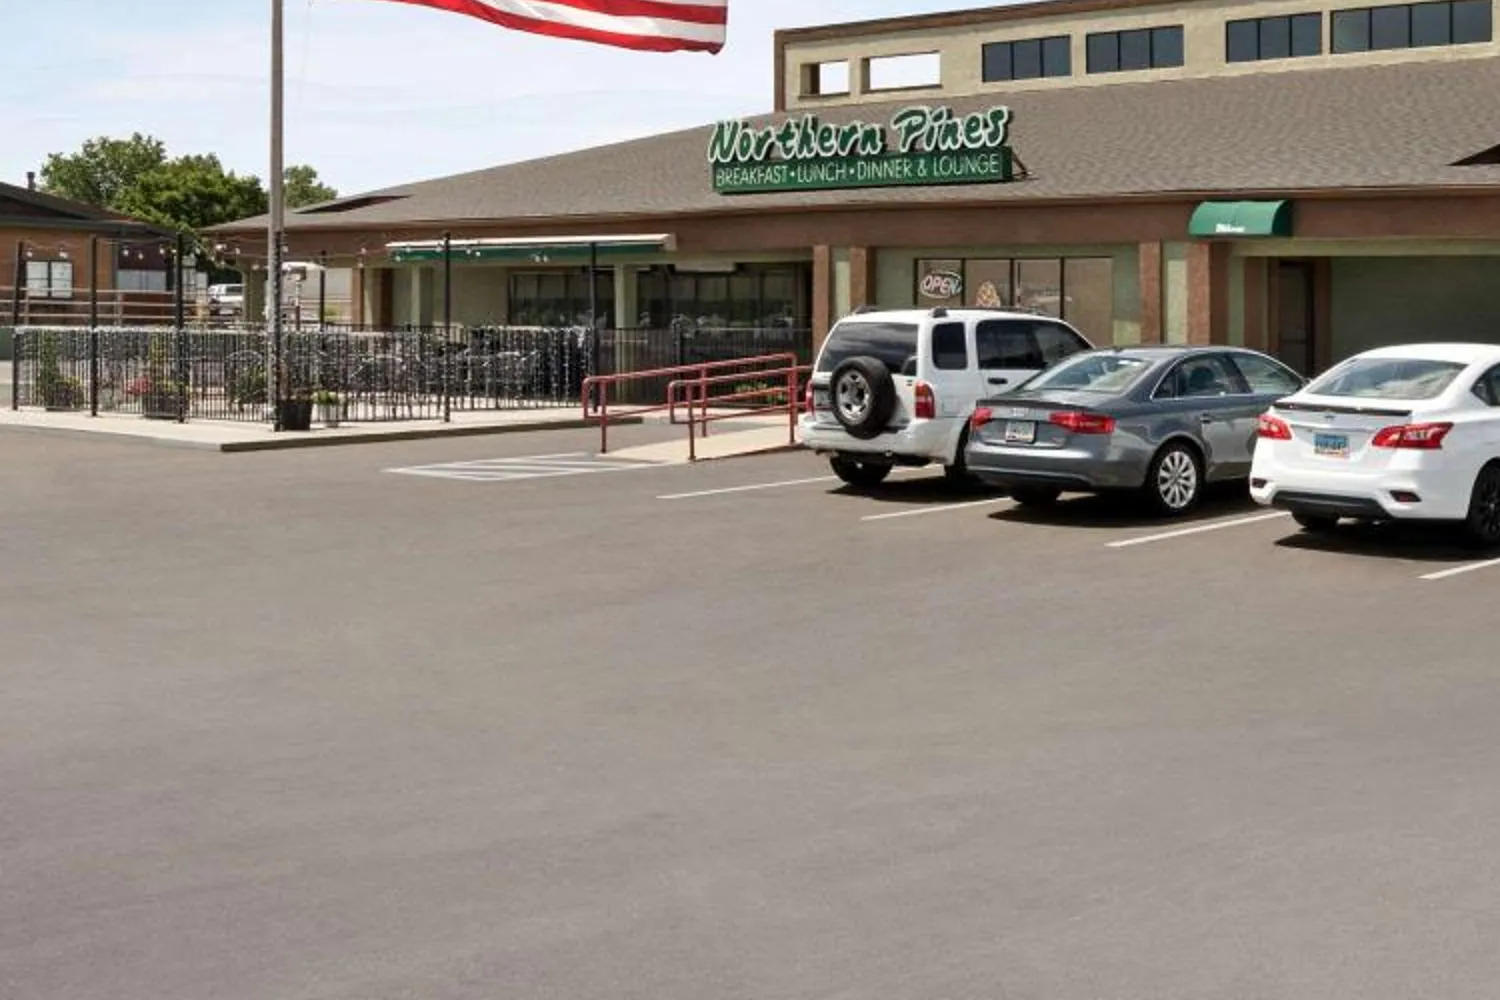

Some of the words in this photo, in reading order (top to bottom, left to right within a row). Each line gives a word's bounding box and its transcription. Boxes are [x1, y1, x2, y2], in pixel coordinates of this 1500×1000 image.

[707, 113, 883, 163] Northern
[891, 105, 1009, 153] Pines
[715, 165, 789, 187] BREAKFAST
[797, 161, 848, 183] LUNCH
[857, 157, 913, 181] DINNER
[917, 158, 928, 177] &
[932, 152, 1000, 177] LOUNGE
[923, 275, 962, 295] OPEN
